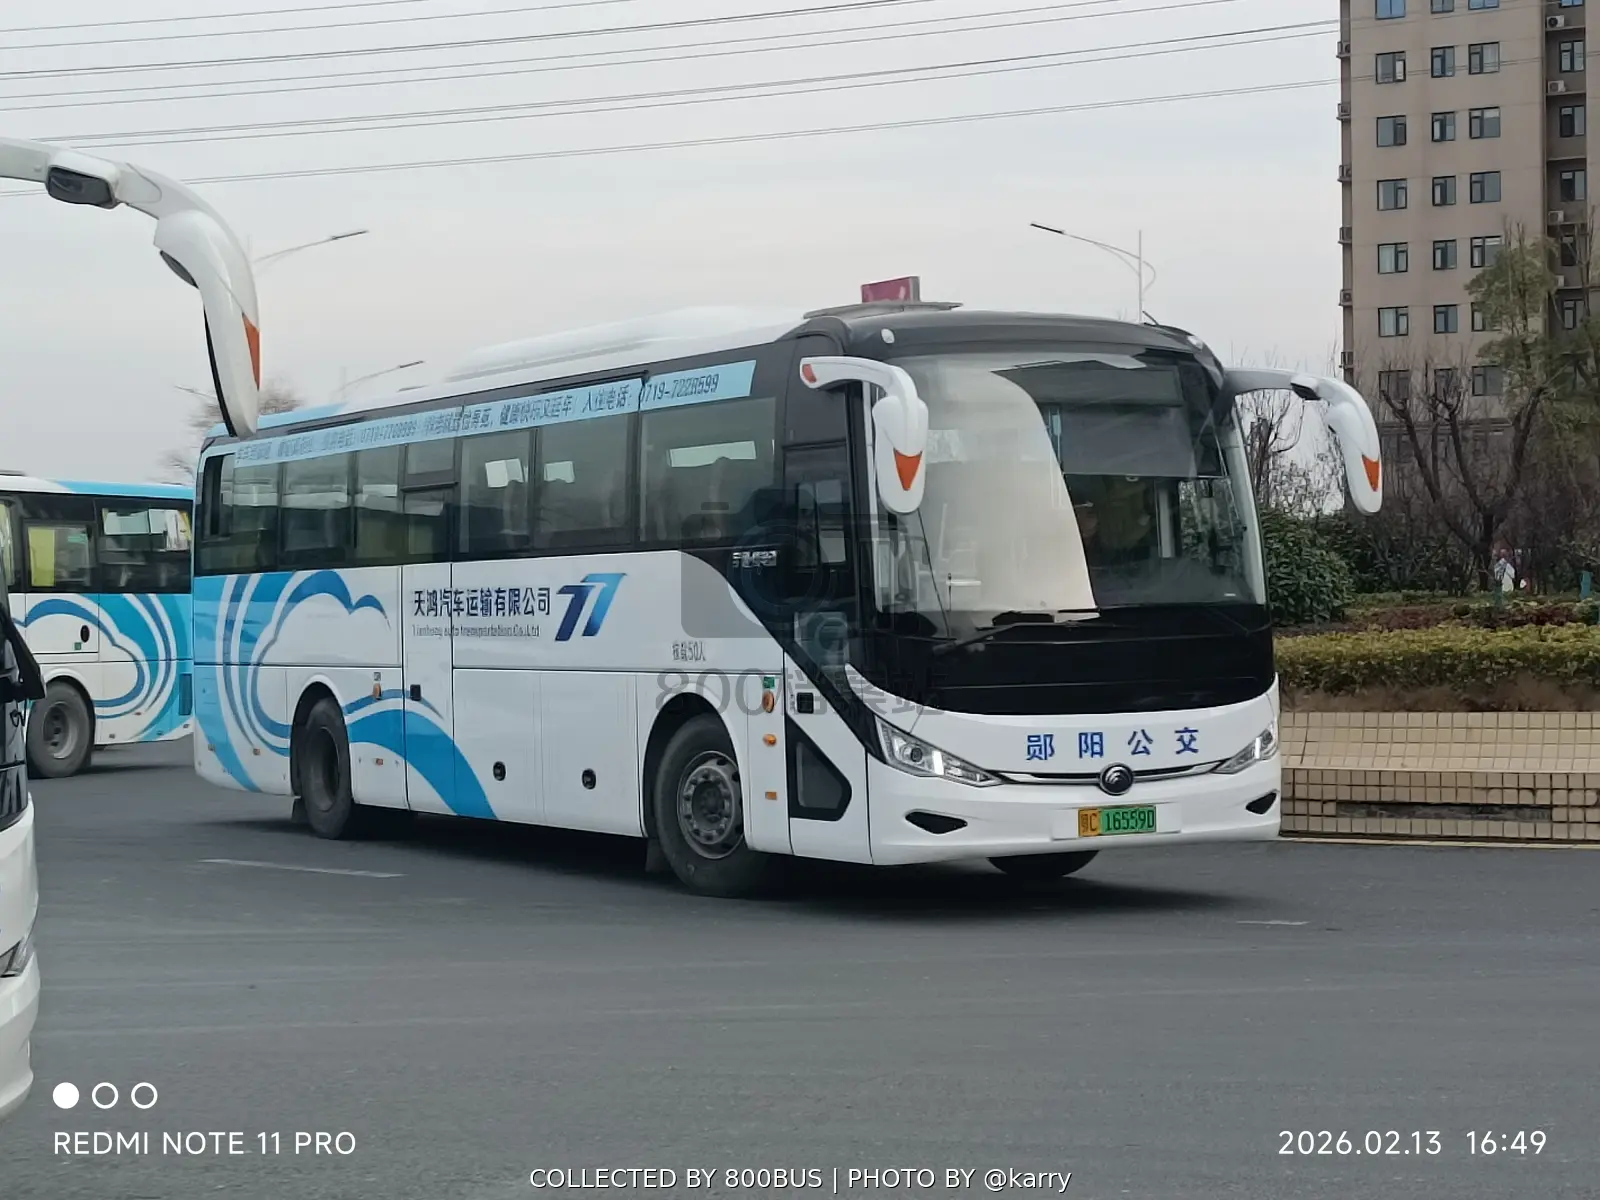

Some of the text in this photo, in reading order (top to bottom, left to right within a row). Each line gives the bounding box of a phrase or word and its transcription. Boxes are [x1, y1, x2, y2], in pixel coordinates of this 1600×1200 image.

[413, 587, 551, 617] 天鸿汽车运输有限公司
[1026, 727, 1199, 760] 郧阳公交
